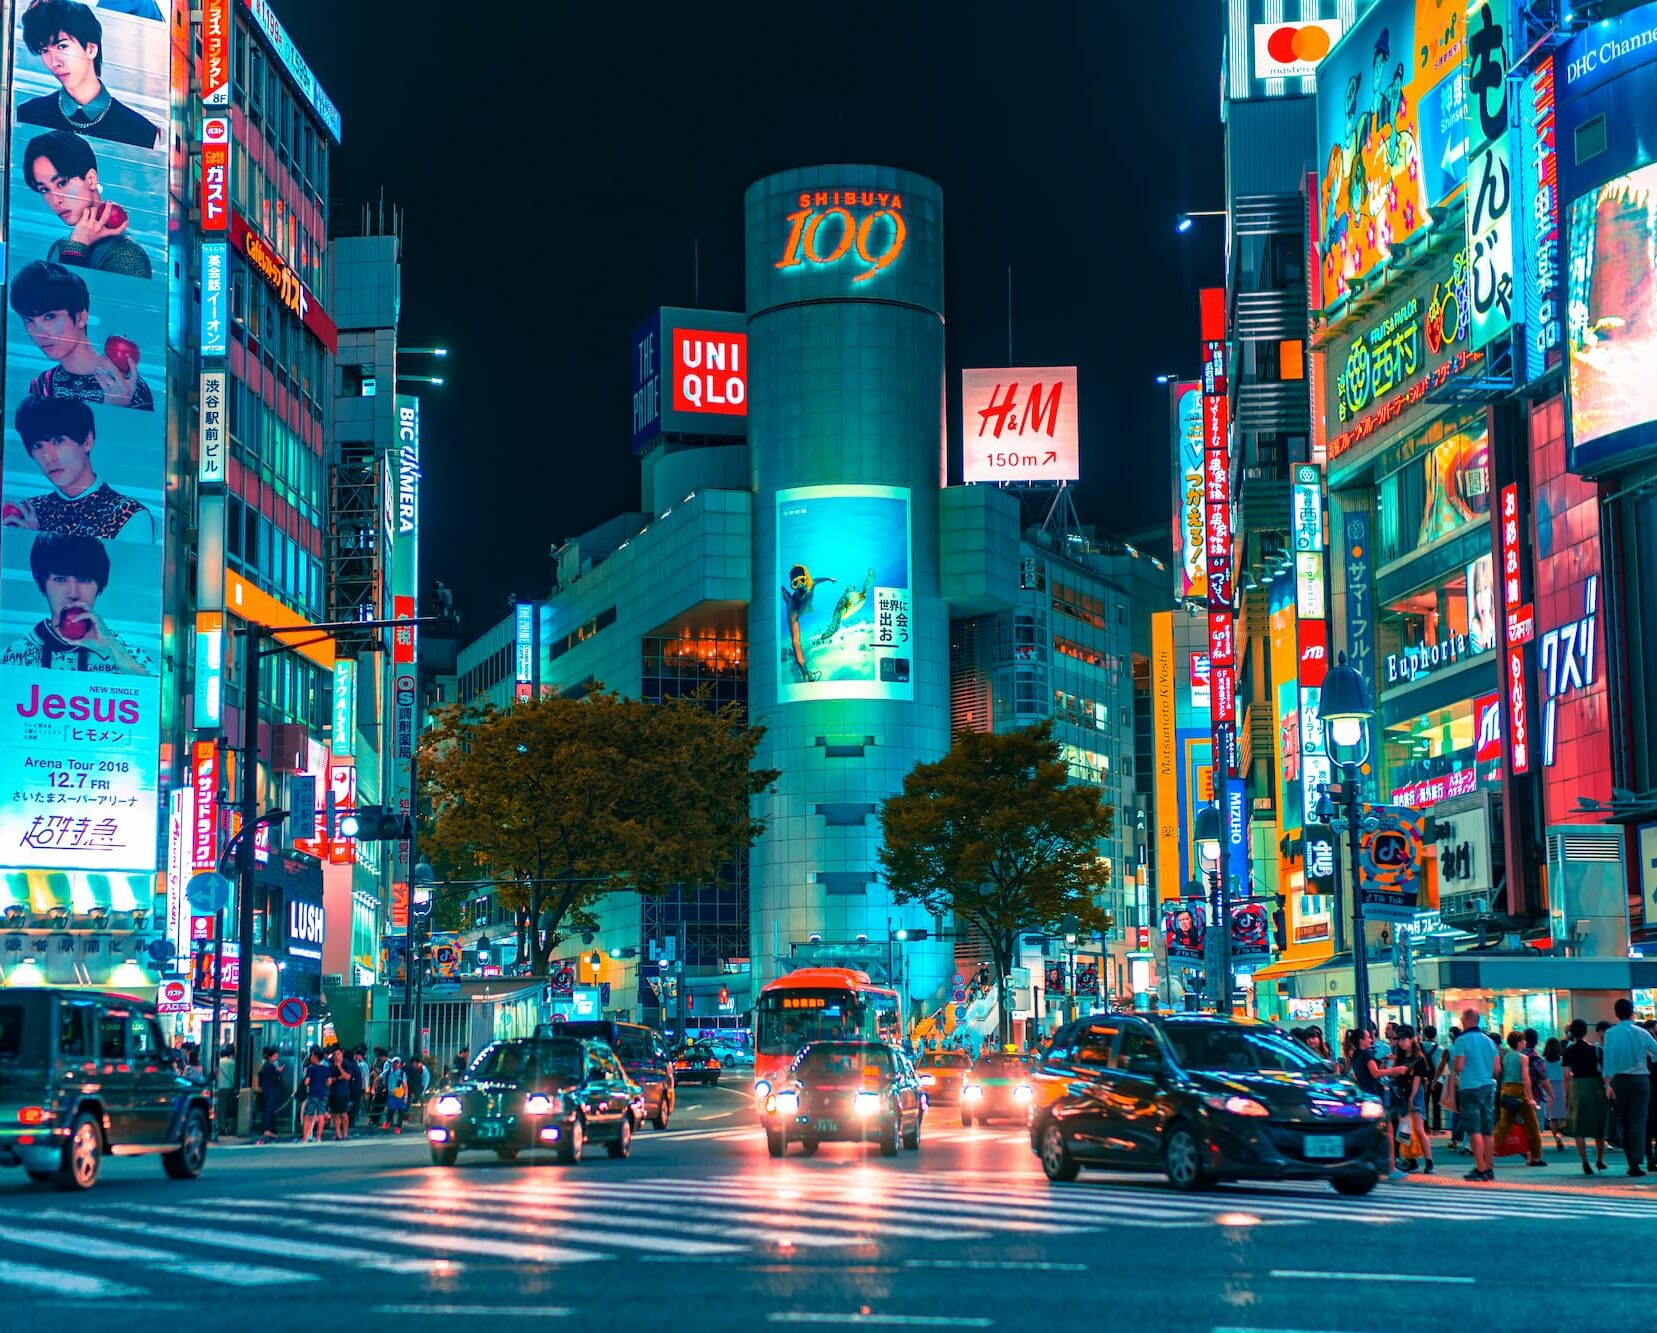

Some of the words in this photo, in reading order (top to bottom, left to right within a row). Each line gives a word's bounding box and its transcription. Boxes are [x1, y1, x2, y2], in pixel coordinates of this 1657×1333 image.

[1567, 52, 1598, 85] DHC
[1600, 27, 1657, 64] Channe
[213, 94, 227, 103] 8F
[206, 165, 224, 219] ガスト
[799, 191, 902, 209] SHIBUYA
[774, 206, 907, 282] 109
[207, 254, 221, 345] 英会話イーオン
[638, 332, 655, 384] THE
[682, 339, 739, 372] UNI
[1371, 320, 1418, 398] 西村
[633, 375, 659, 436] PRIME
[682, 373, 745, 408] QLO
[977, 381, 1063, 439] H&M
[204, 379, 220, 473] 渋谷駅前ビル
[399, 407, 415, 441] BIC
[399, 444, 423, 534] CAMERA
[878, 599, 908, 612] 世界に
[1386, 627, 1466, 682] Euphoria
[16, 684, 140, 724] Jesus
[90, 686, 108, 694] NEW
[110, 687, 139, 696] SINGLE
[24, 757, 62, 769] Arena
[68, 760, 94, 771] Tour
[99, 761, 129, 773] 2018
[47, 772, 88, 789] 12.7
[90, 781, 110, 790] FRI
[12, 790, 138, 807] さいたまスーパーアリーナ
[197, 775, 213, 861] サンドラッグ
[1230, 792, 1242, 844] MIZUHO
[290, 900, 324, 944] LUSH
